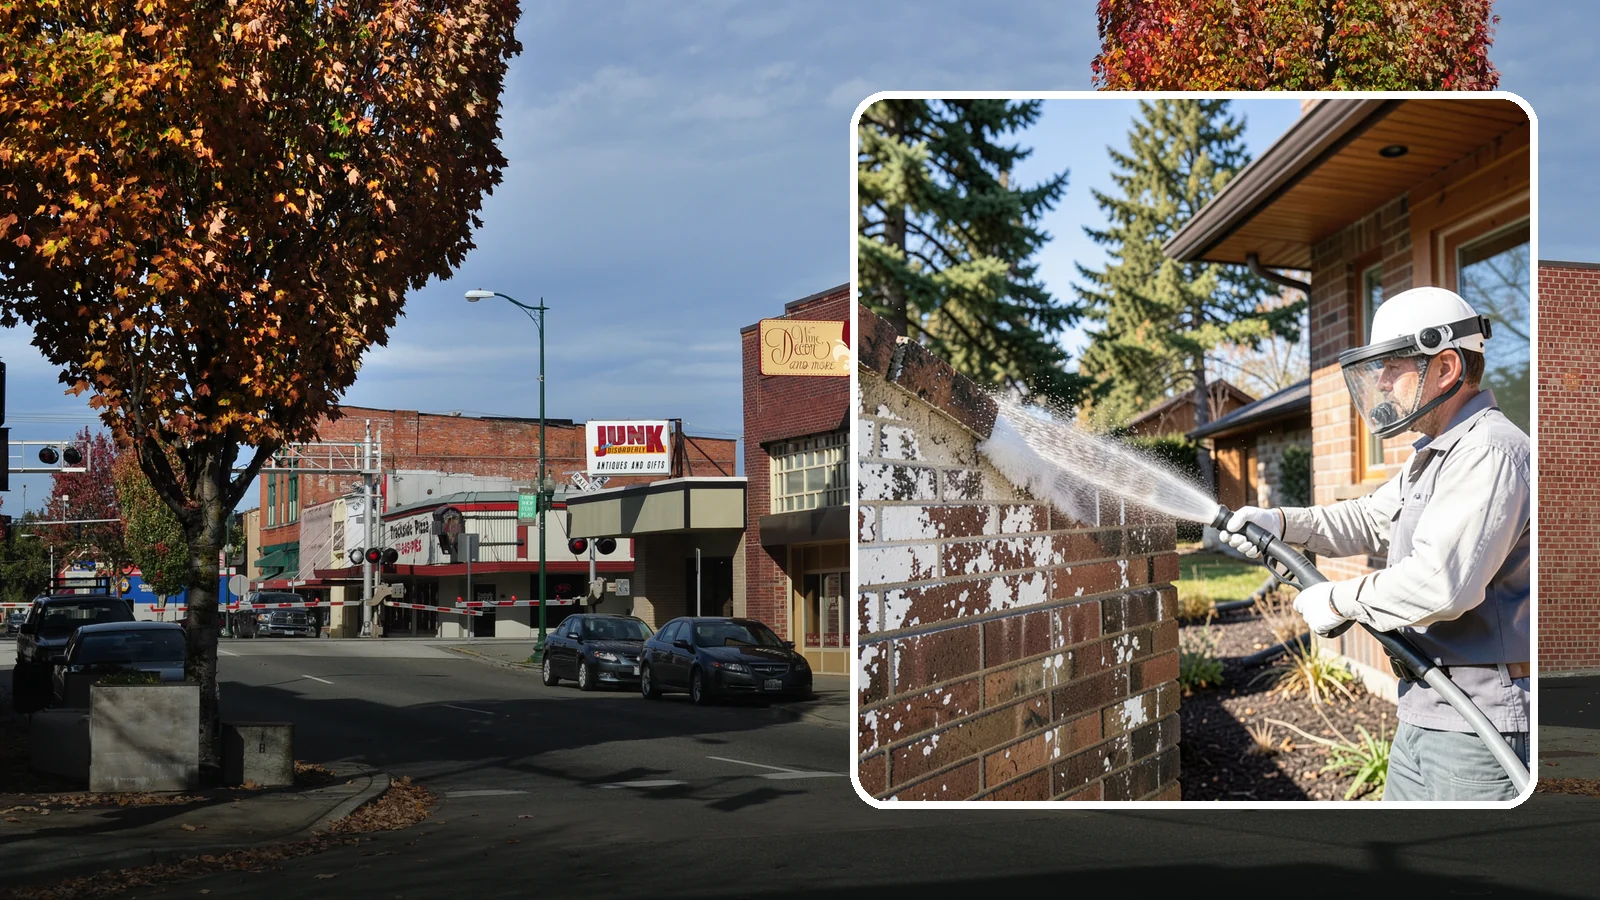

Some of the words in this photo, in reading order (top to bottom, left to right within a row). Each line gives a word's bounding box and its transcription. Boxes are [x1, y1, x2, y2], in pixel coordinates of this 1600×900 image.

[595, 425, 664, 457] JUNK
[607, 446, 646, 454] DISORDERLY
[596, 461, 628, 470] ANTIQUES
[631, 461, 644, 470] AND
[647, 460, 665, 470] GIFTS
[415, 519, 429, 535] Pizza
